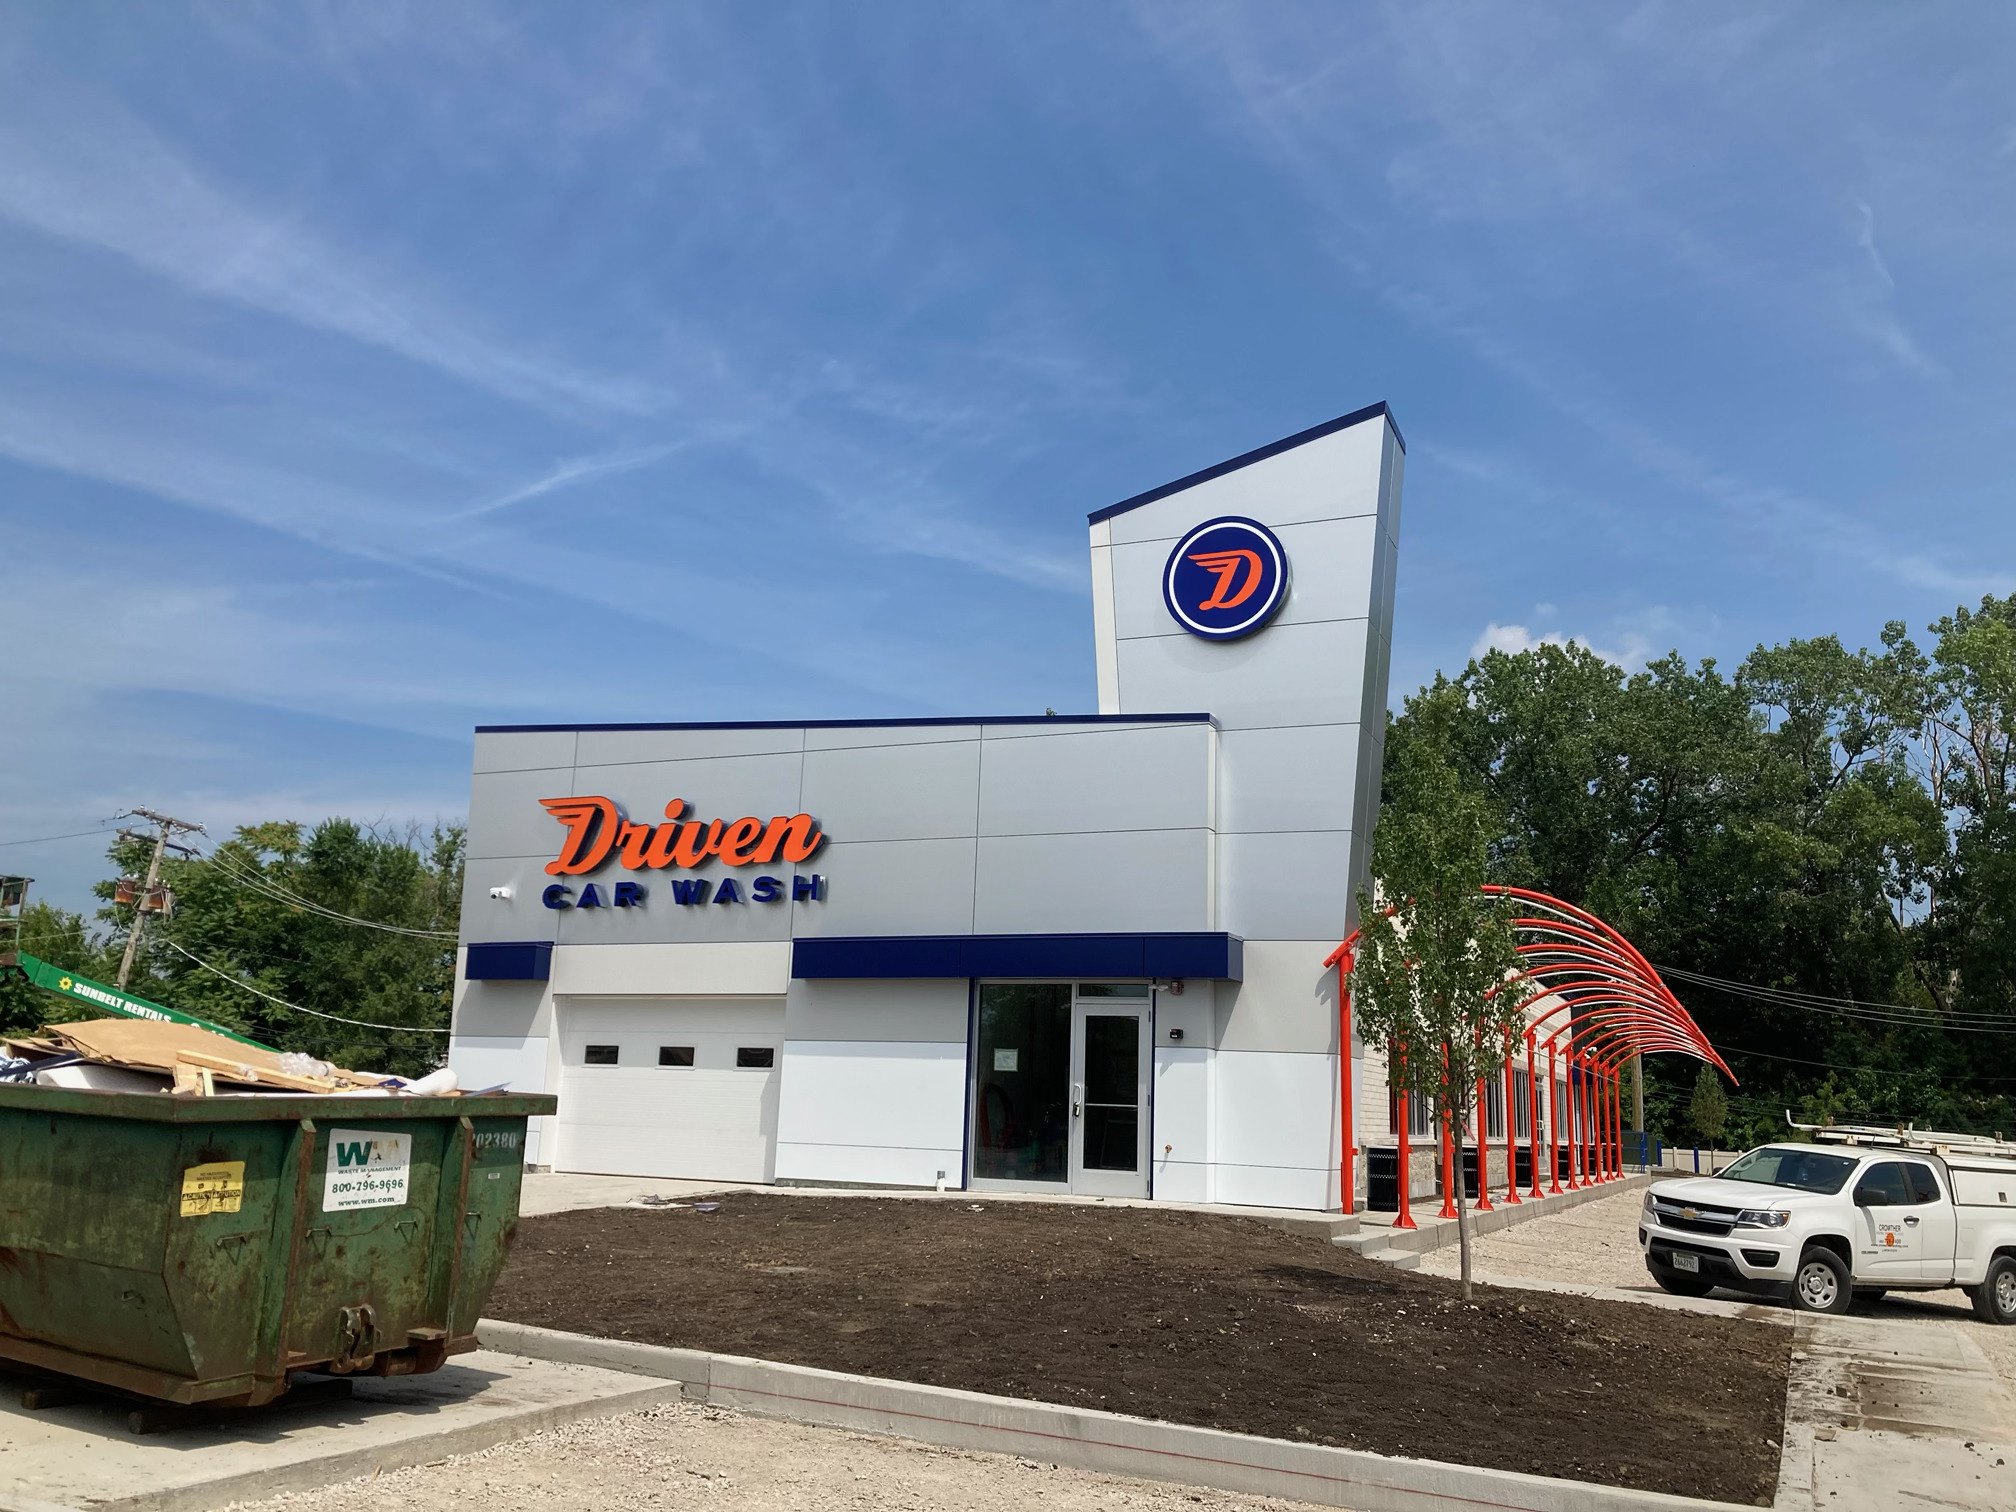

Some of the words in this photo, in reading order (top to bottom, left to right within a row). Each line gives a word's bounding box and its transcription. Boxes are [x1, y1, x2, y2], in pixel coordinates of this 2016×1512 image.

[1187, 549, 1263, 611] D
[537, 795, 823, 876] Driven
[542, 881, 644, 909] CAR
[671, 873, 826, 905] WASH
[73, 982, 124, 1009] SUNBELT
[123, 1000, 172, 1023] RENTALS
[331, 1178, 404, 1194] 800-796-9696
[337, 1167, 359, 1175] WASTE
[337, 1196, 395, 1207] www.wm.com
